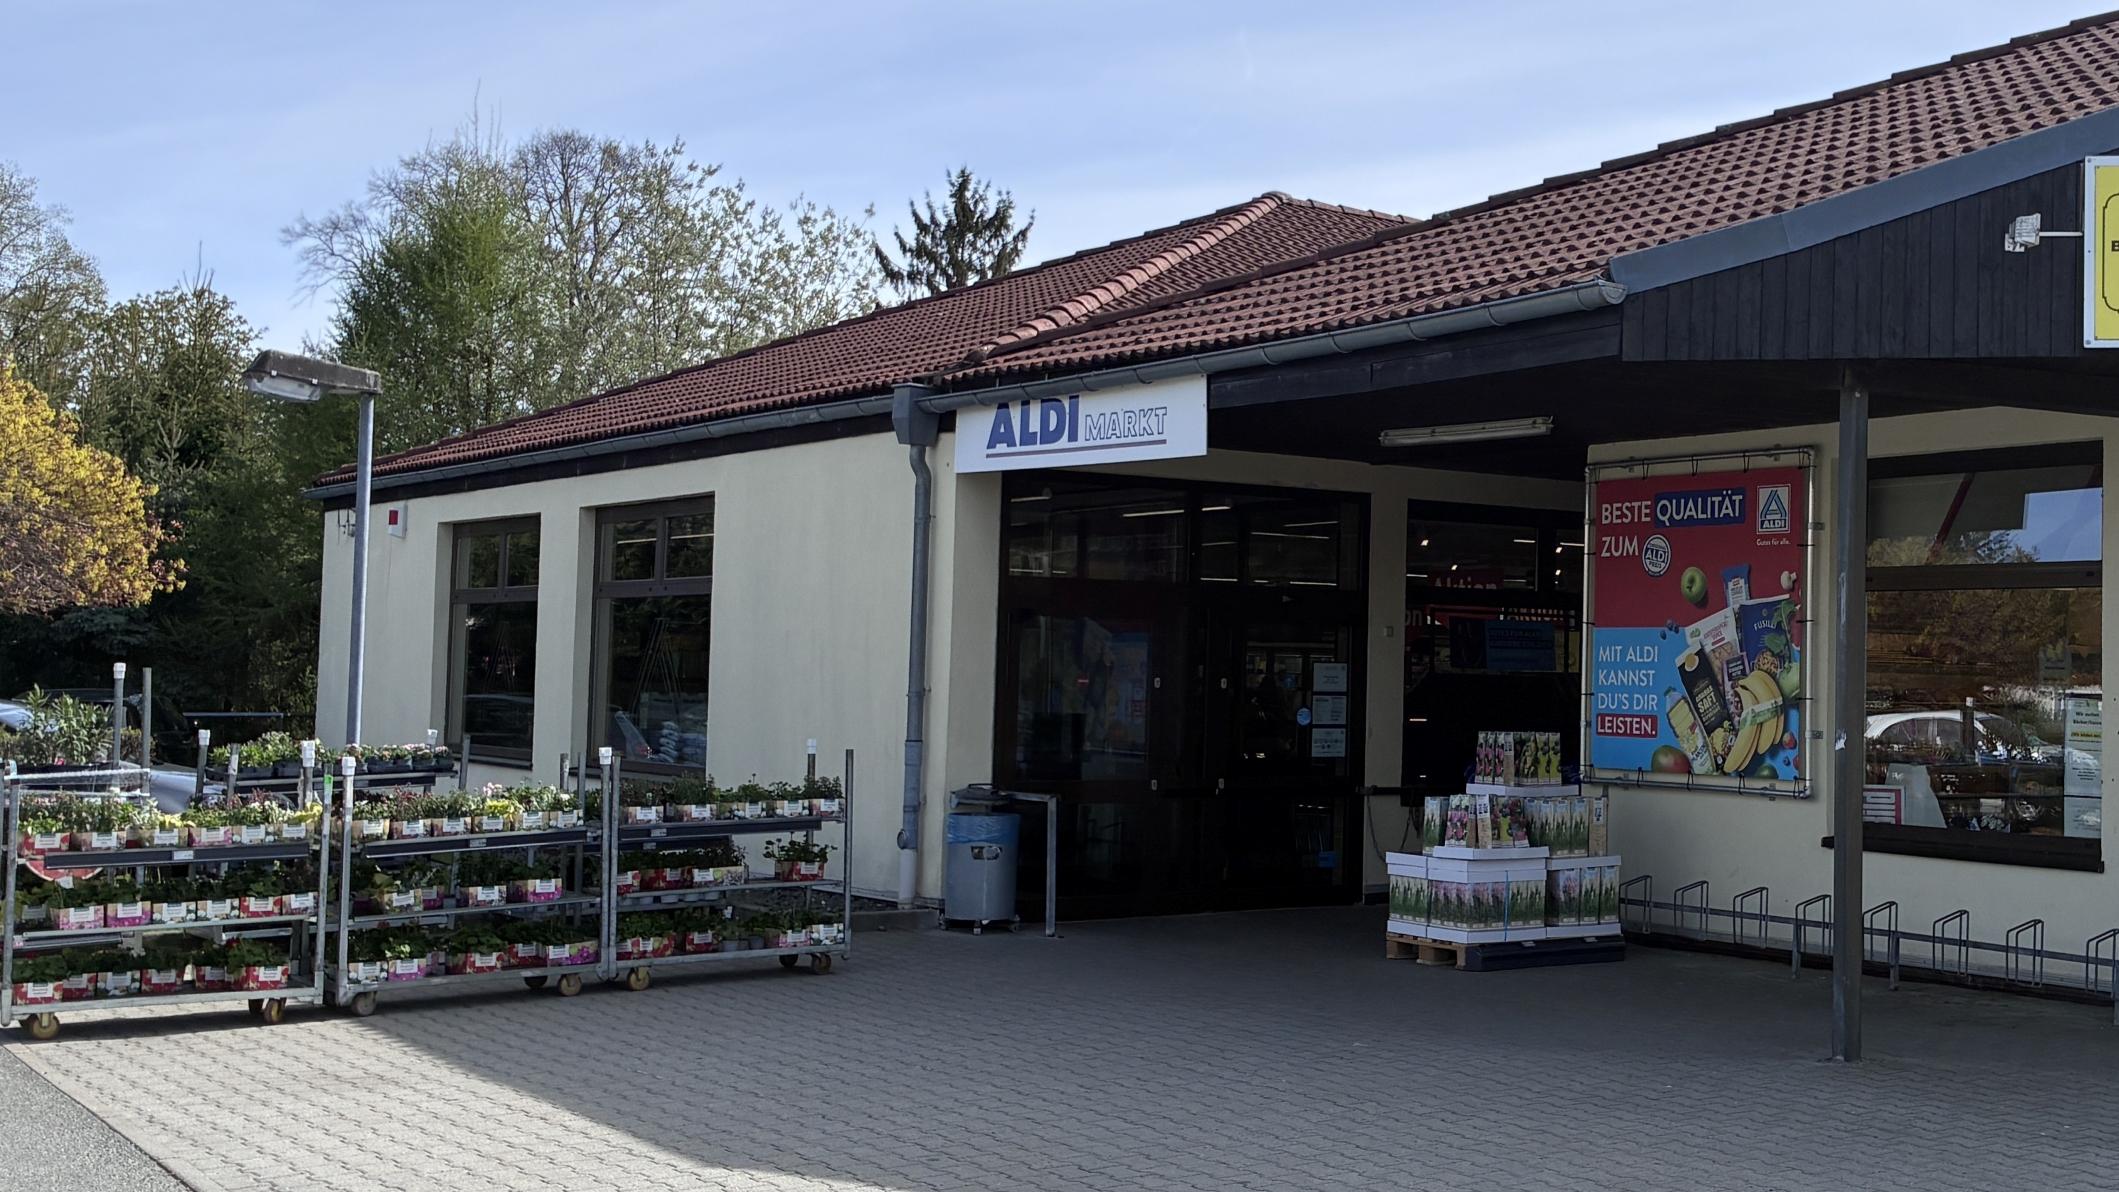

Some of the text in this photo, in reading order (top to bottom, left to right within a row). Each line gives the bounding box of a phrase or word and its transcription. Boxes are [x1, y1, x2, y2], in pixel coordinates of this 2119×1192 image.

[986, 394, 1168, 450] ALDI MARKT
[1601, 490, 1743, 527] BESTE QUALITÄT
[1762, 519, 1785, 529] ALDI
[1601, 535, 1639, 558] ZUM
[1645, 548, 1668, 564] ALDI
[1599, 645, 1658, 663] MIT ALDI
[1598, 669, 1656, 687] KANNST
[1598, 692, 1658, 711] DU'S DIR
[1697, 691, 1717, 713] SAFT
[1597, 715, 1656, 735] LEISTEN.
